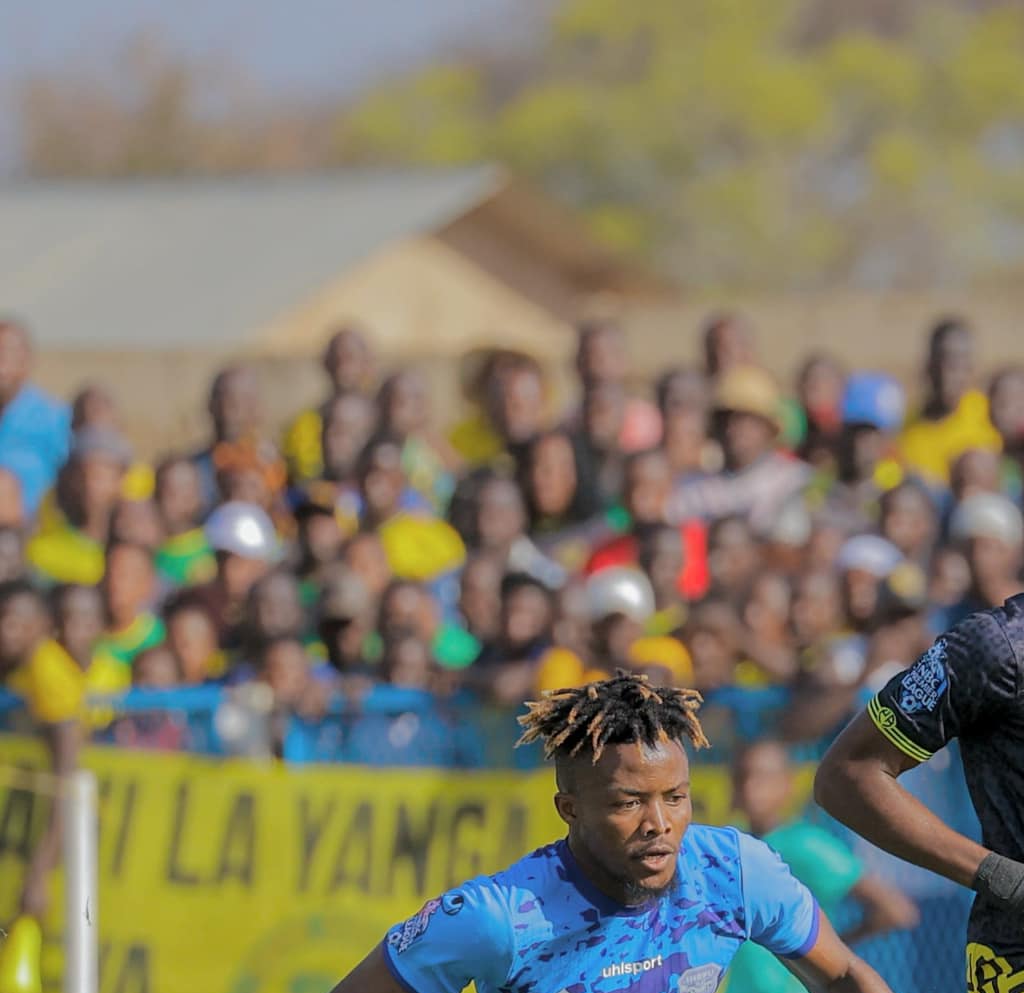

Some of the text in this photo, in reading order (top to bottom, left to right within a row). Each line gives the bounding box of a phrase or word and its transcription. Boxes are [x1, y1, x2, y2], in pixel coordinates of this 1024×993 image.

[902, 674, 937, 712] LEAGUE
[162, 778, 259, 890] LA
[602, 955, 663, 978] uhlsport
